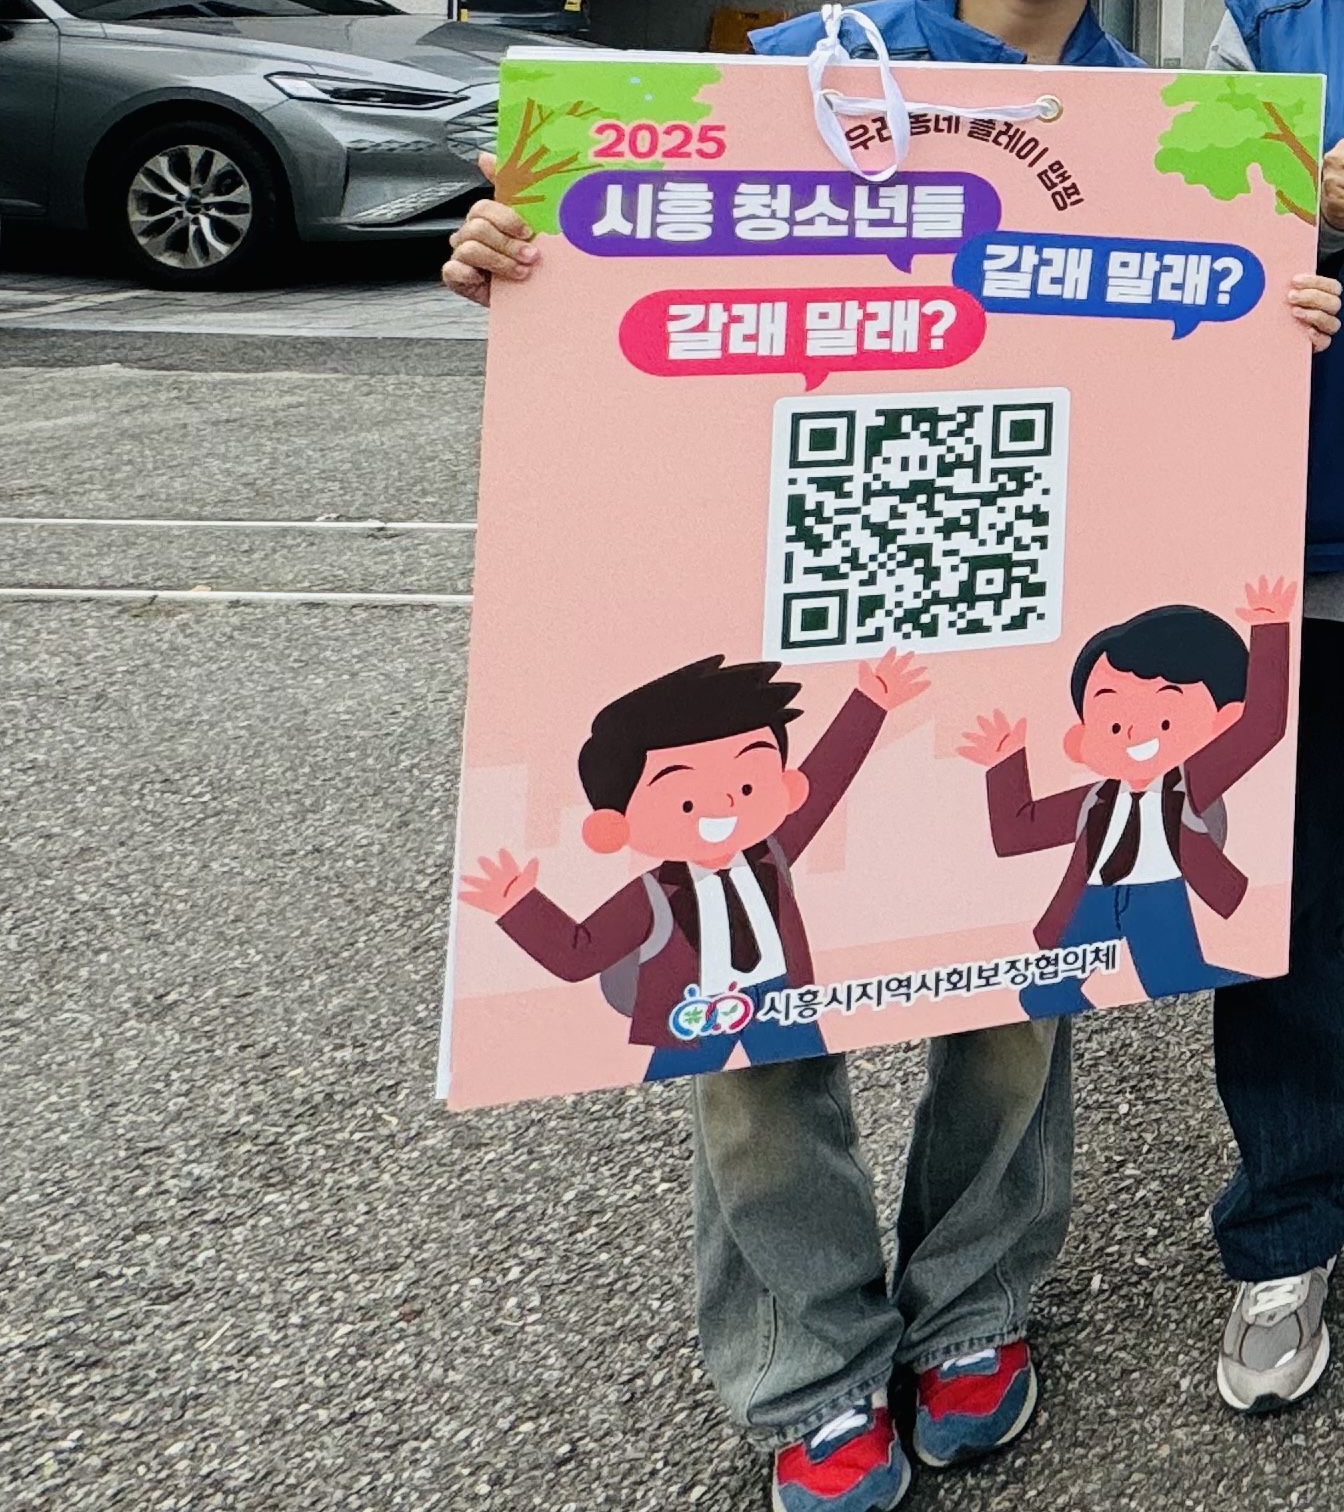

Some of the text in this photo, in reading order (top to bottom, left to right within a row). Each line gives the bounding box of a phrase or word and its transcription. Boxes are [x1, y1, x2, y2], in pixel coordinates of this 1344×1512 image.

[593, 123, 727, 160] 2025
[592, 180, 966, 242] 시흥 청소년들
[1036, 160, 1085, 212] 맵핑
[982, 244, 1245, 307] 갈래 말래?
[667, 299, 959, 361] 갈래 말래?
[761, 943, 1119, 1022] 시흥시지역사회보장협의체
